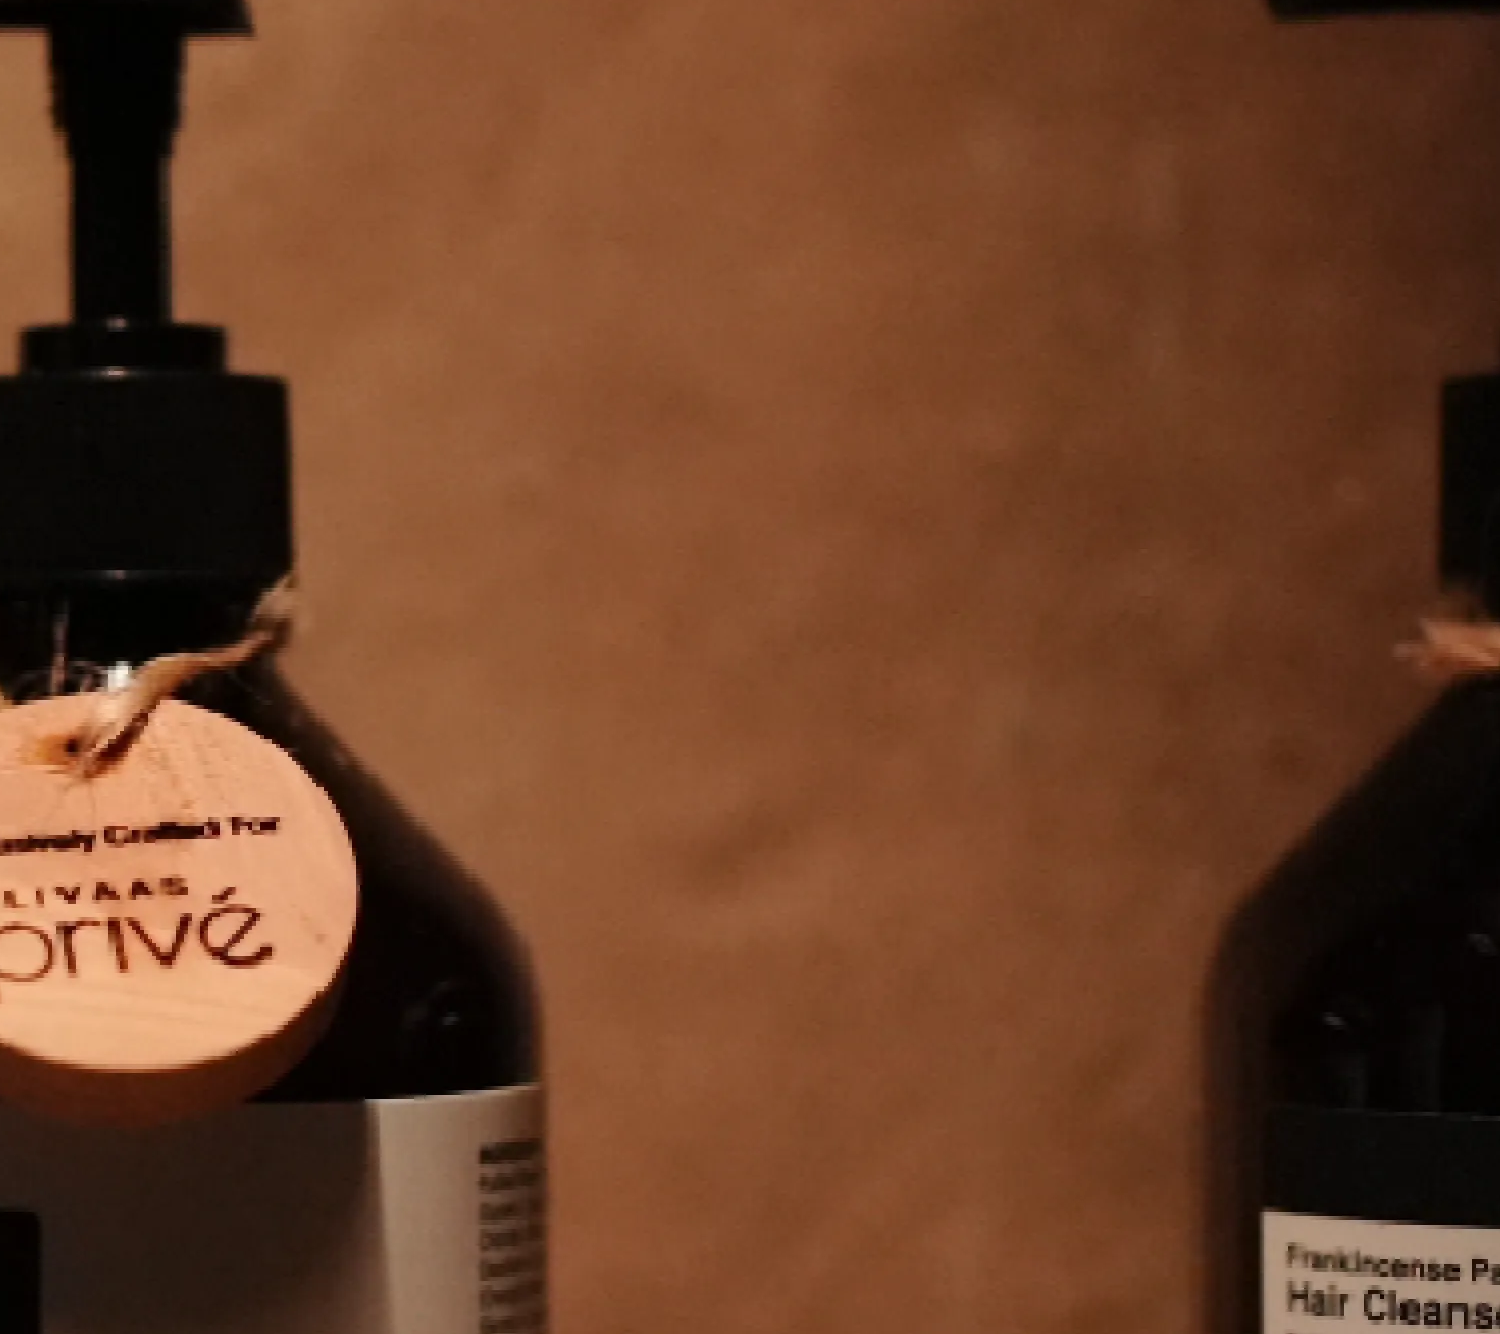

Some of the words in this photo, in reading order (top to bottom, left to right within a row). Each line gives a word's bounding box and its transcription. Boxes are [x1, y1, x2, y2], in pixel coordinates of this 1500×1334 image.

[104, 818, 221, 849] Crafted
[231, 814, 282, 838] For
[1287, 1243, 1462, 1283] Frankincense
[1287, 1280, 1350, 1319] Hair
